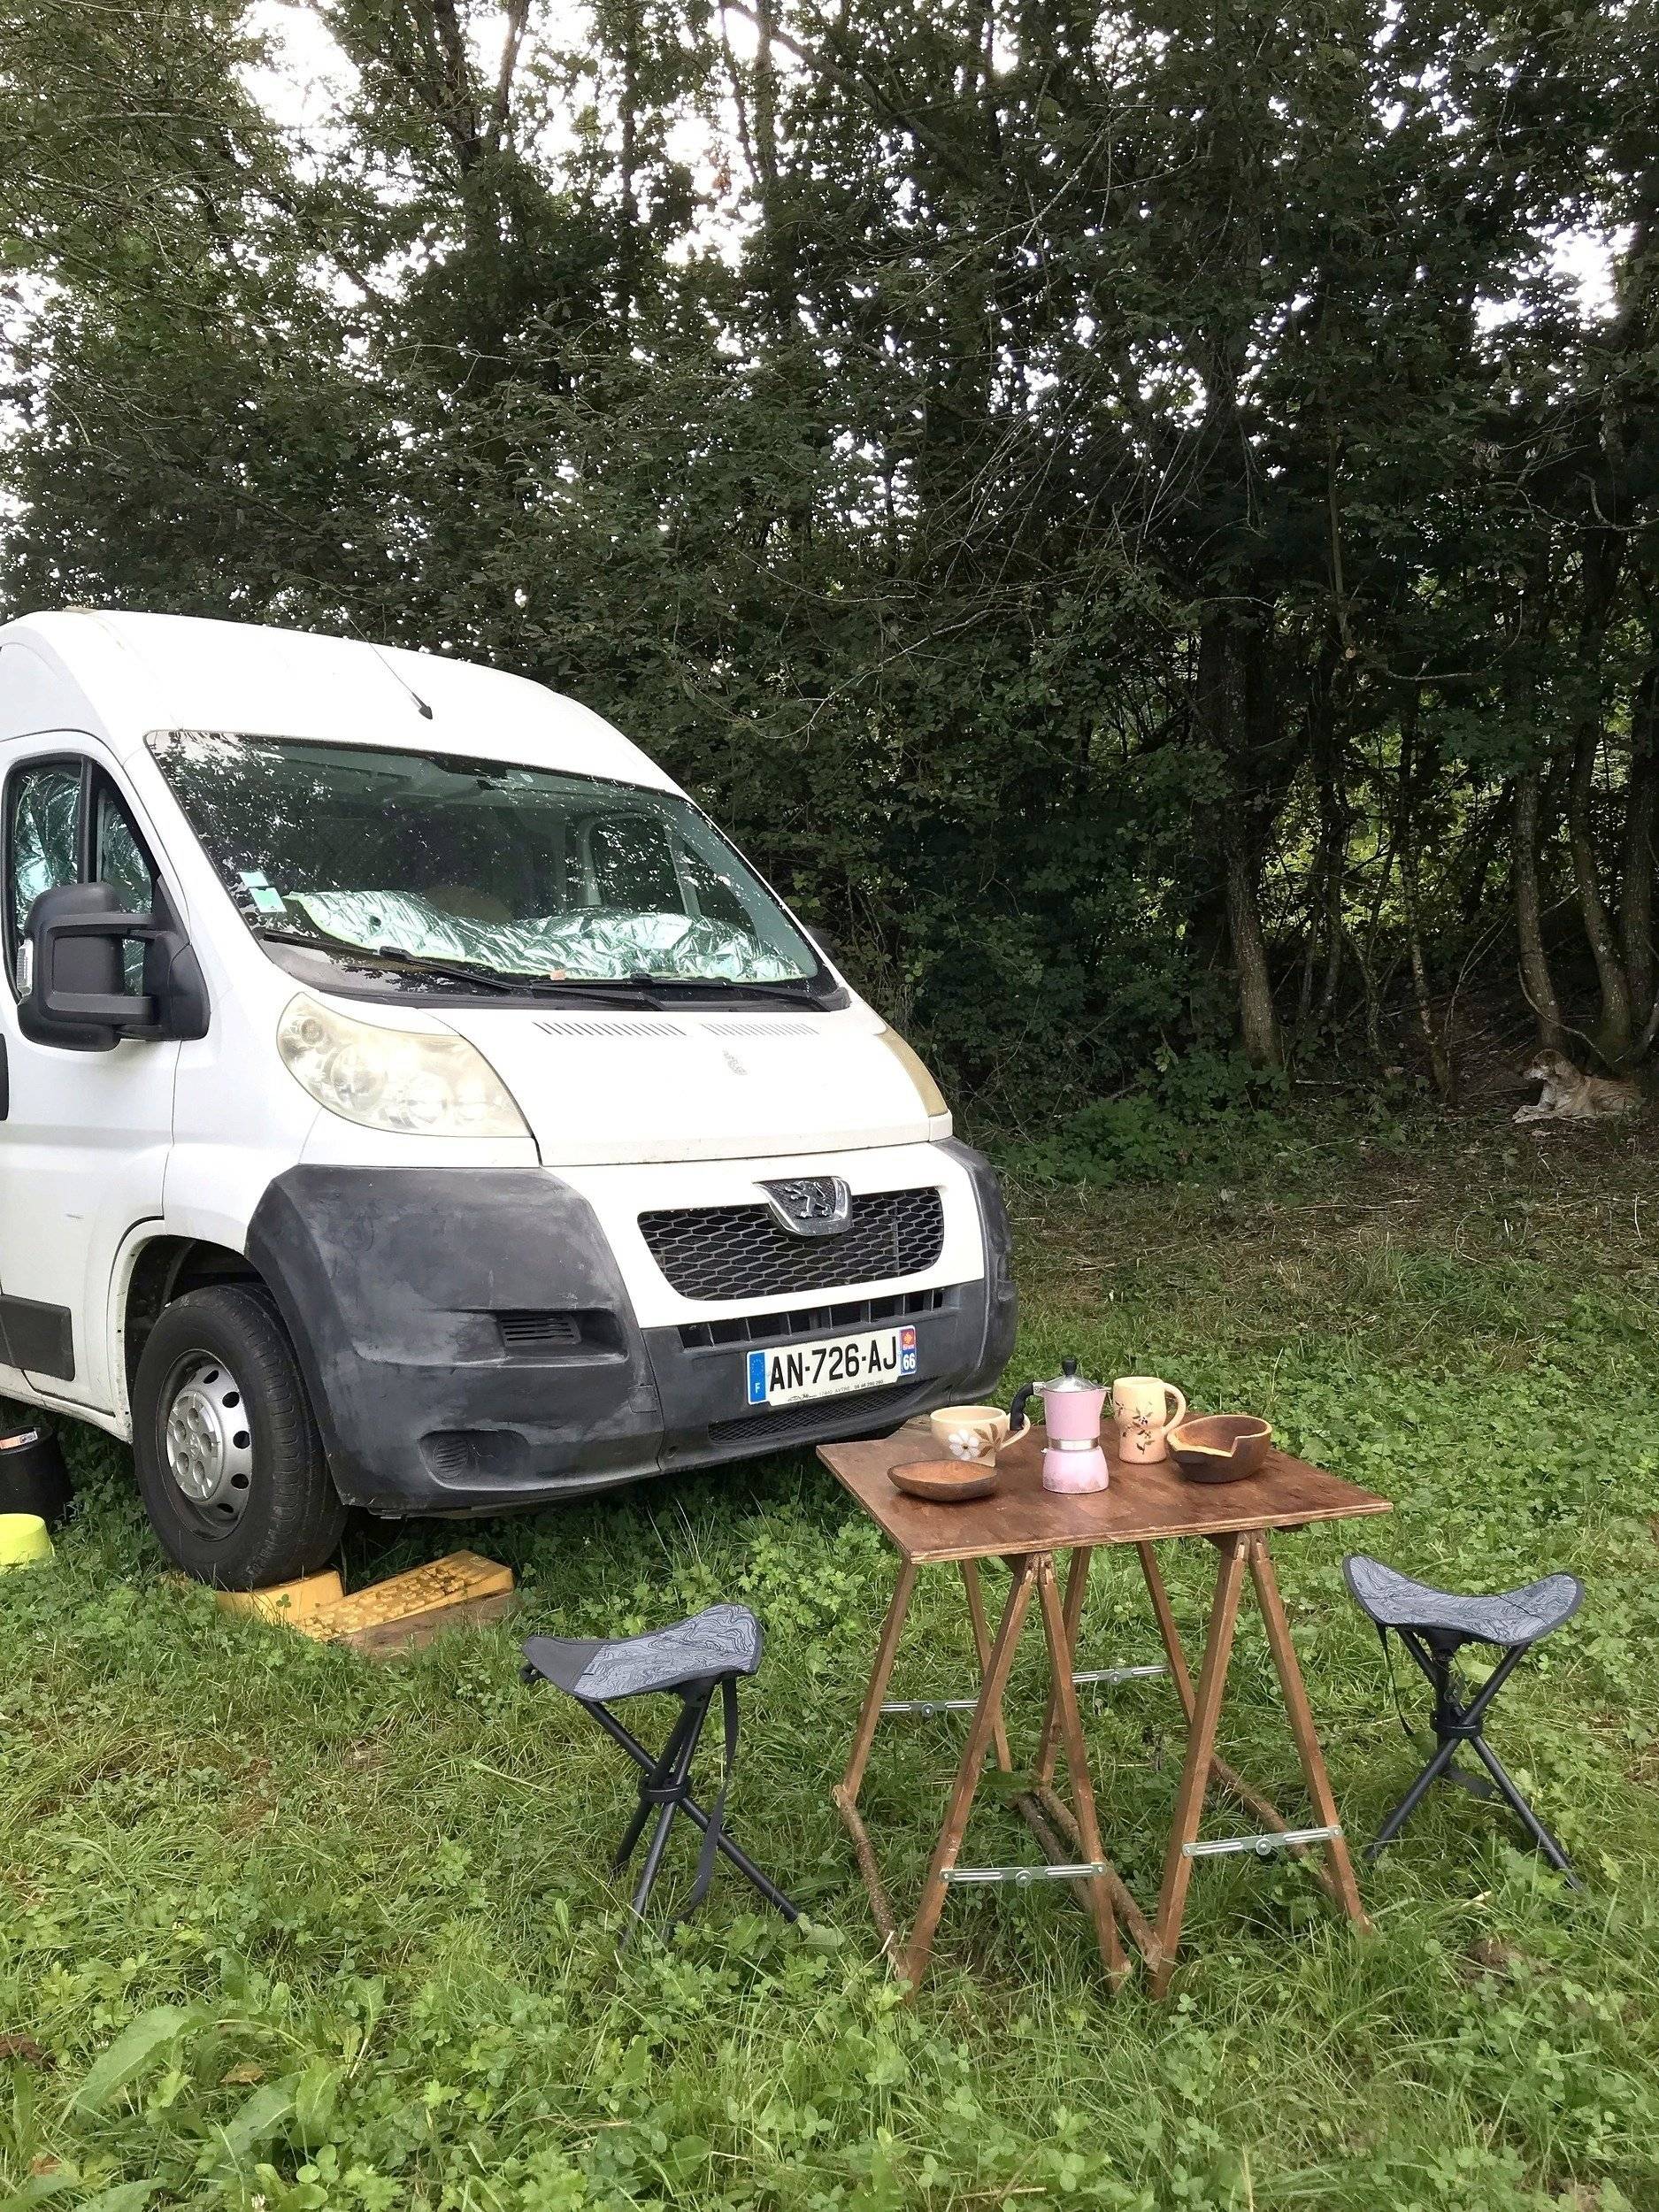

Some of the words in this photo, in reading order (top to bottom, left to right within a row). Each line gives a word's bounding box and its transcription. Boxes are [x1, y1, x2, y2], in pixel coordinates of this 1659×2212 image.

[769, 1336, 897, 1393] AN-726-AJ
[902, 1352, 916, 1371] 66
[755, 1382, 761, 1394] F
